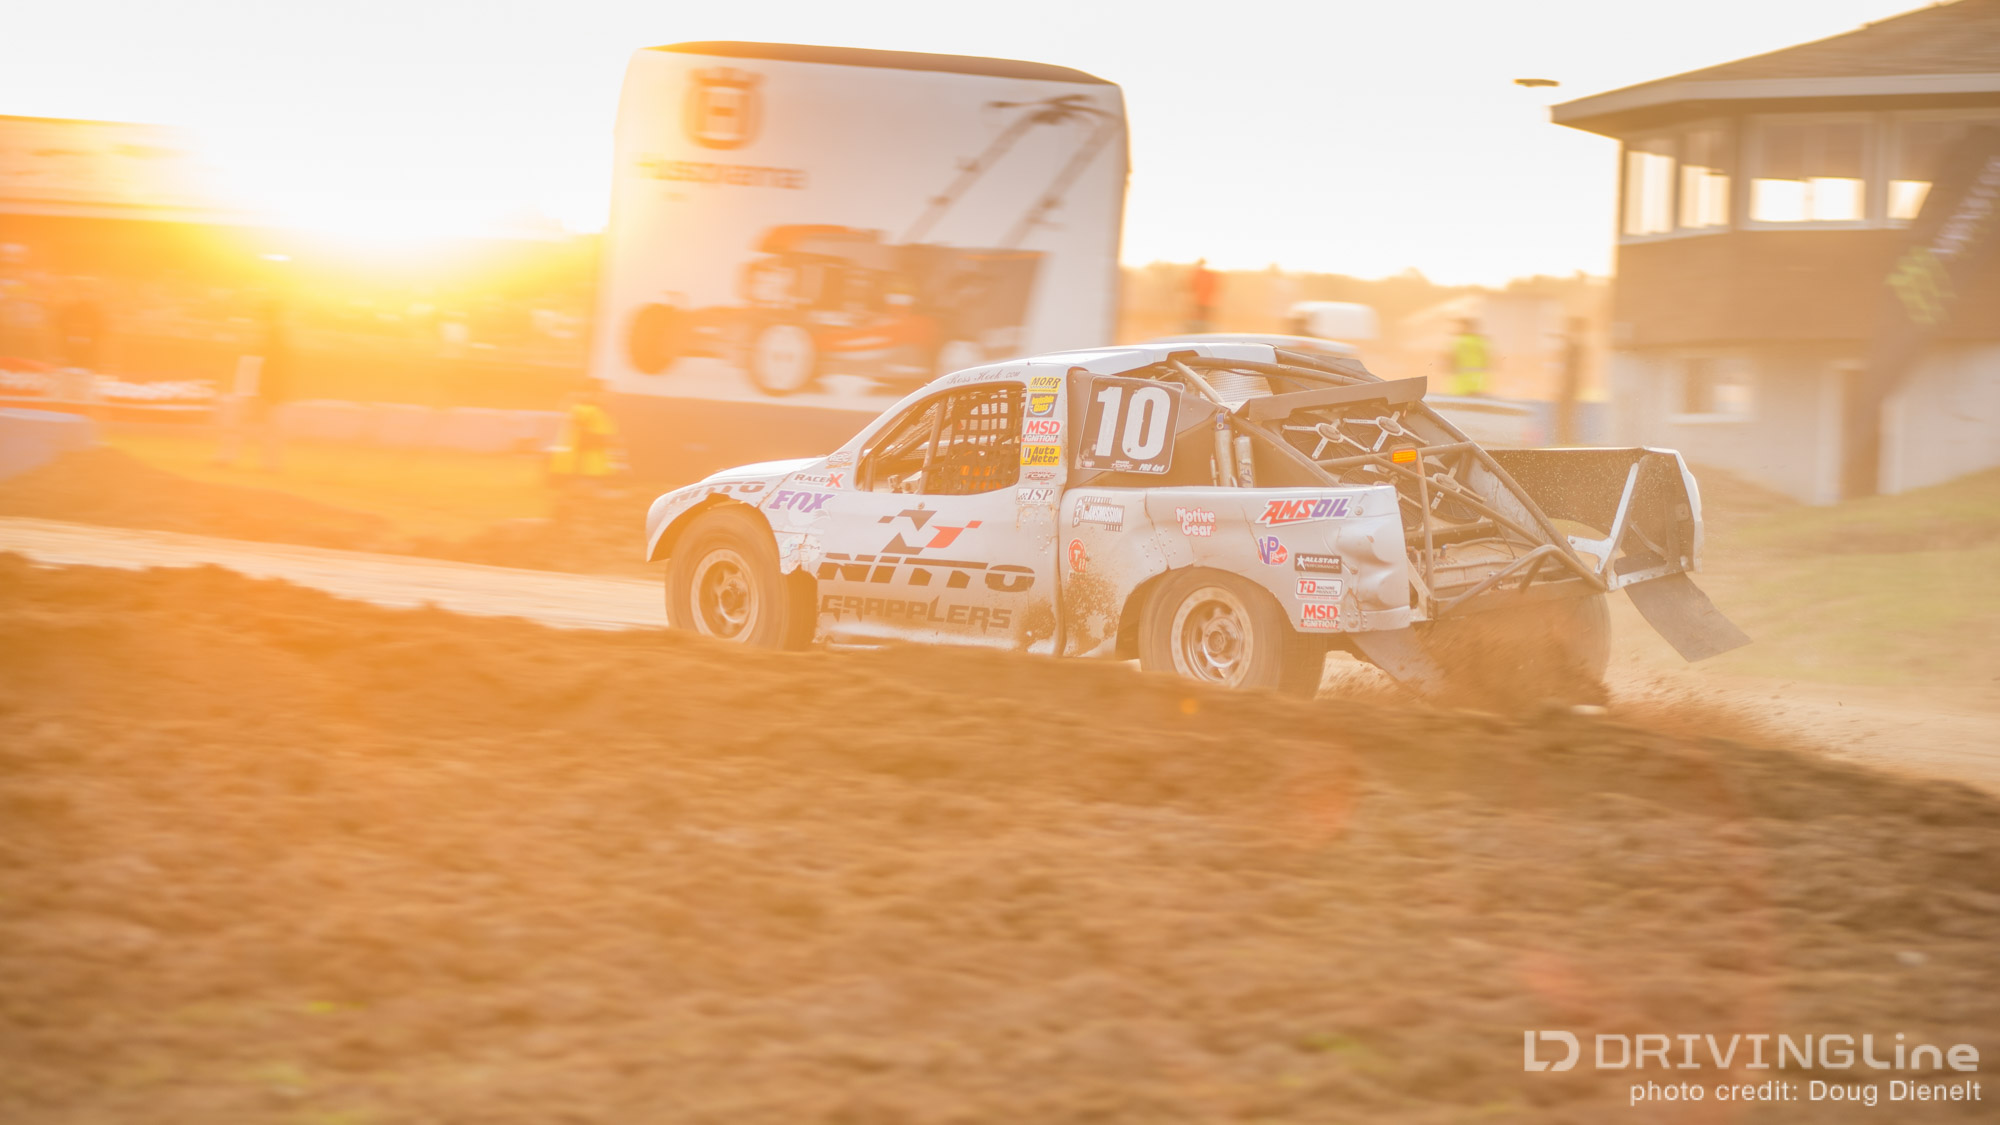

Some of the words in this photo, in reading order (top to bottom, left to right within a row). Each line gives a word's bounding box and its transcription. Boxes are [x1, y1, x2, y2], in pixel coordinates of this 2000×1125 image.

[1031, 377, 1061, 388] MORR
[1026, 421, 1061, 434] MSD
[1095, 386, 1171, 460] 10
[1031, 455, 1058, 463] Meter
[768, 490, 836, 513] FOX
[1027, 489, 1053, 500] ISP
[1176, 508, 1215, 523] Motive
[1260, 498, 1349, 525] AMSOIL
[1182, 521, 1213, 536] Gear
[1259, 536, 1279, 565] VP
[1304, 556, 1339, 564] ALLSTAR
[816, 552, 1036, 593] NITTO
[820, 594, 1013, 635] GRAPPLERS
[1304, 604, 1338, 619] MSD
